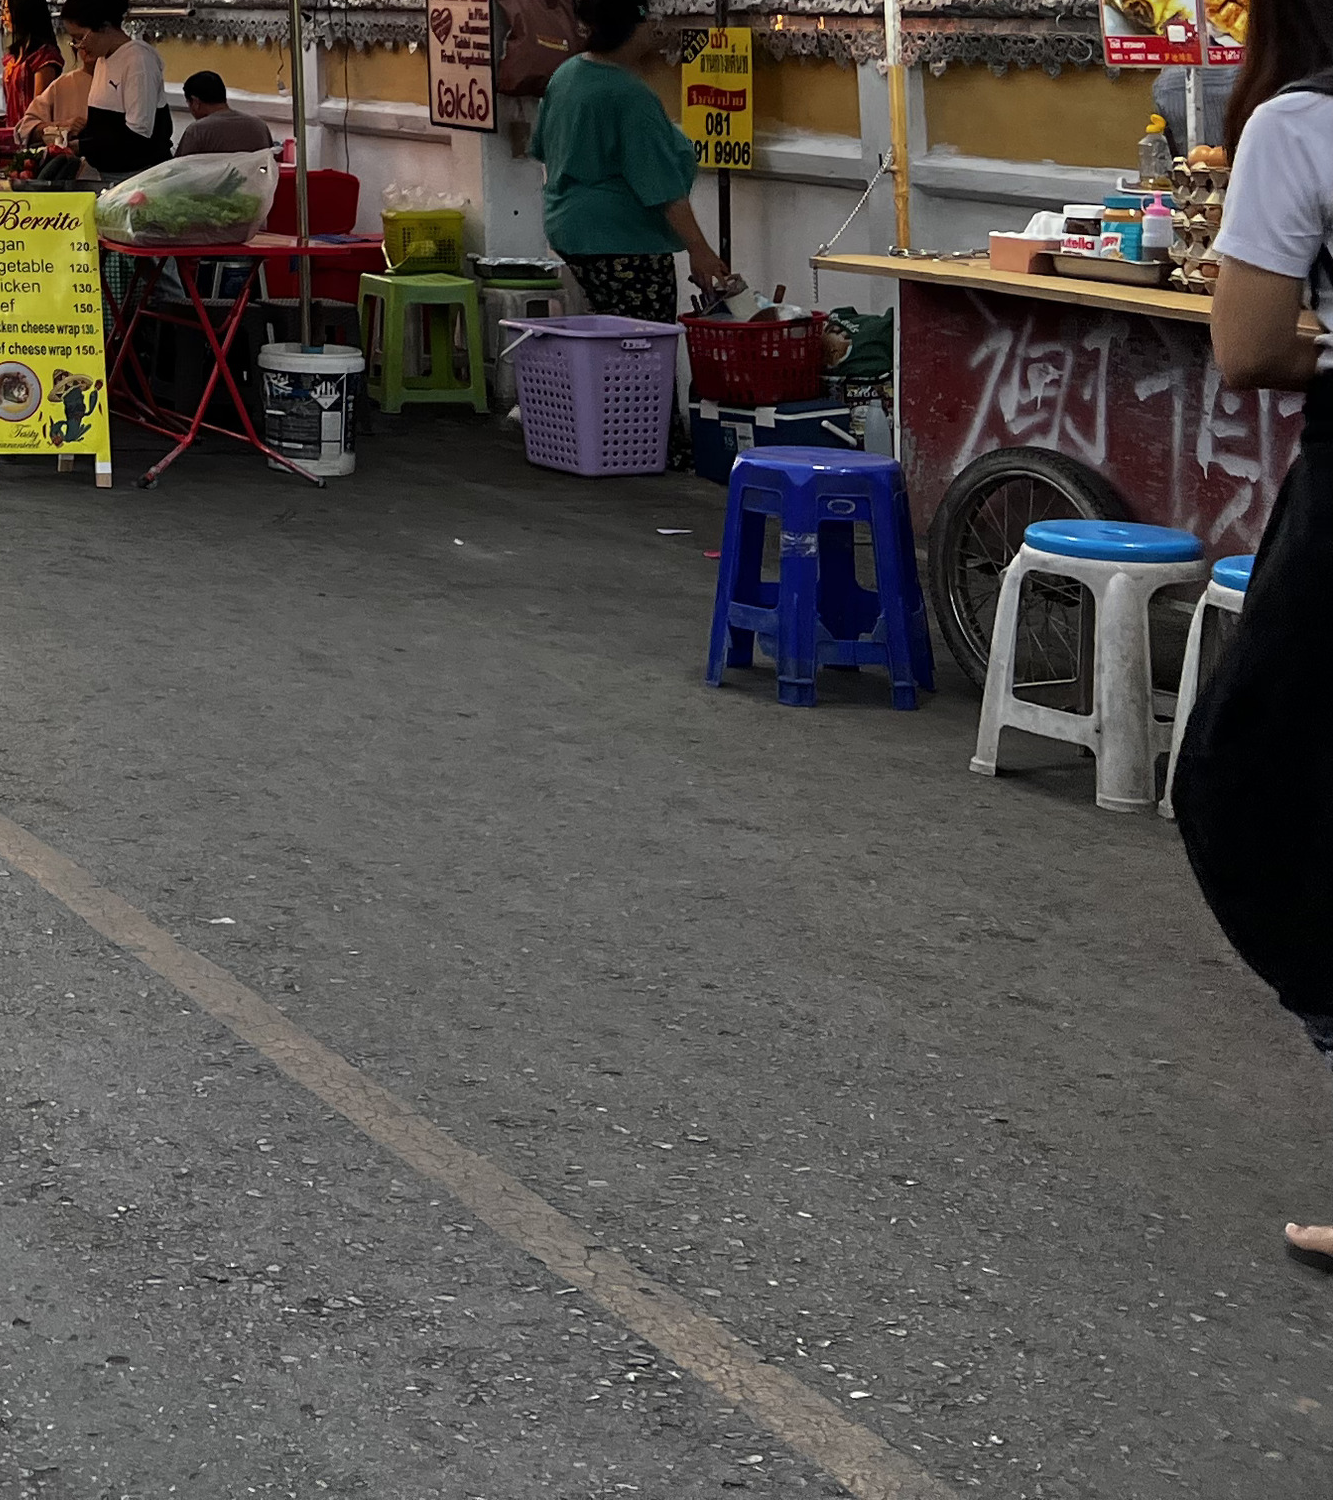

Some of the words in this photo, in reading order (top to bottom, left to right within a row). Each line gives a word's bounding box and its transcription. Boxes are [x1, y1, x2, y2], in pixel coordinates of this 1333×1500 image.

[705, 111, 731, 136] 081
[1062, 236, 1095, 251] utella
[21, 320, 56, 334] cheese
[57, 324, 80, 338] wrap
[8, 341, 47, 355] cheese
[48, 345, 73, 359] wrap
